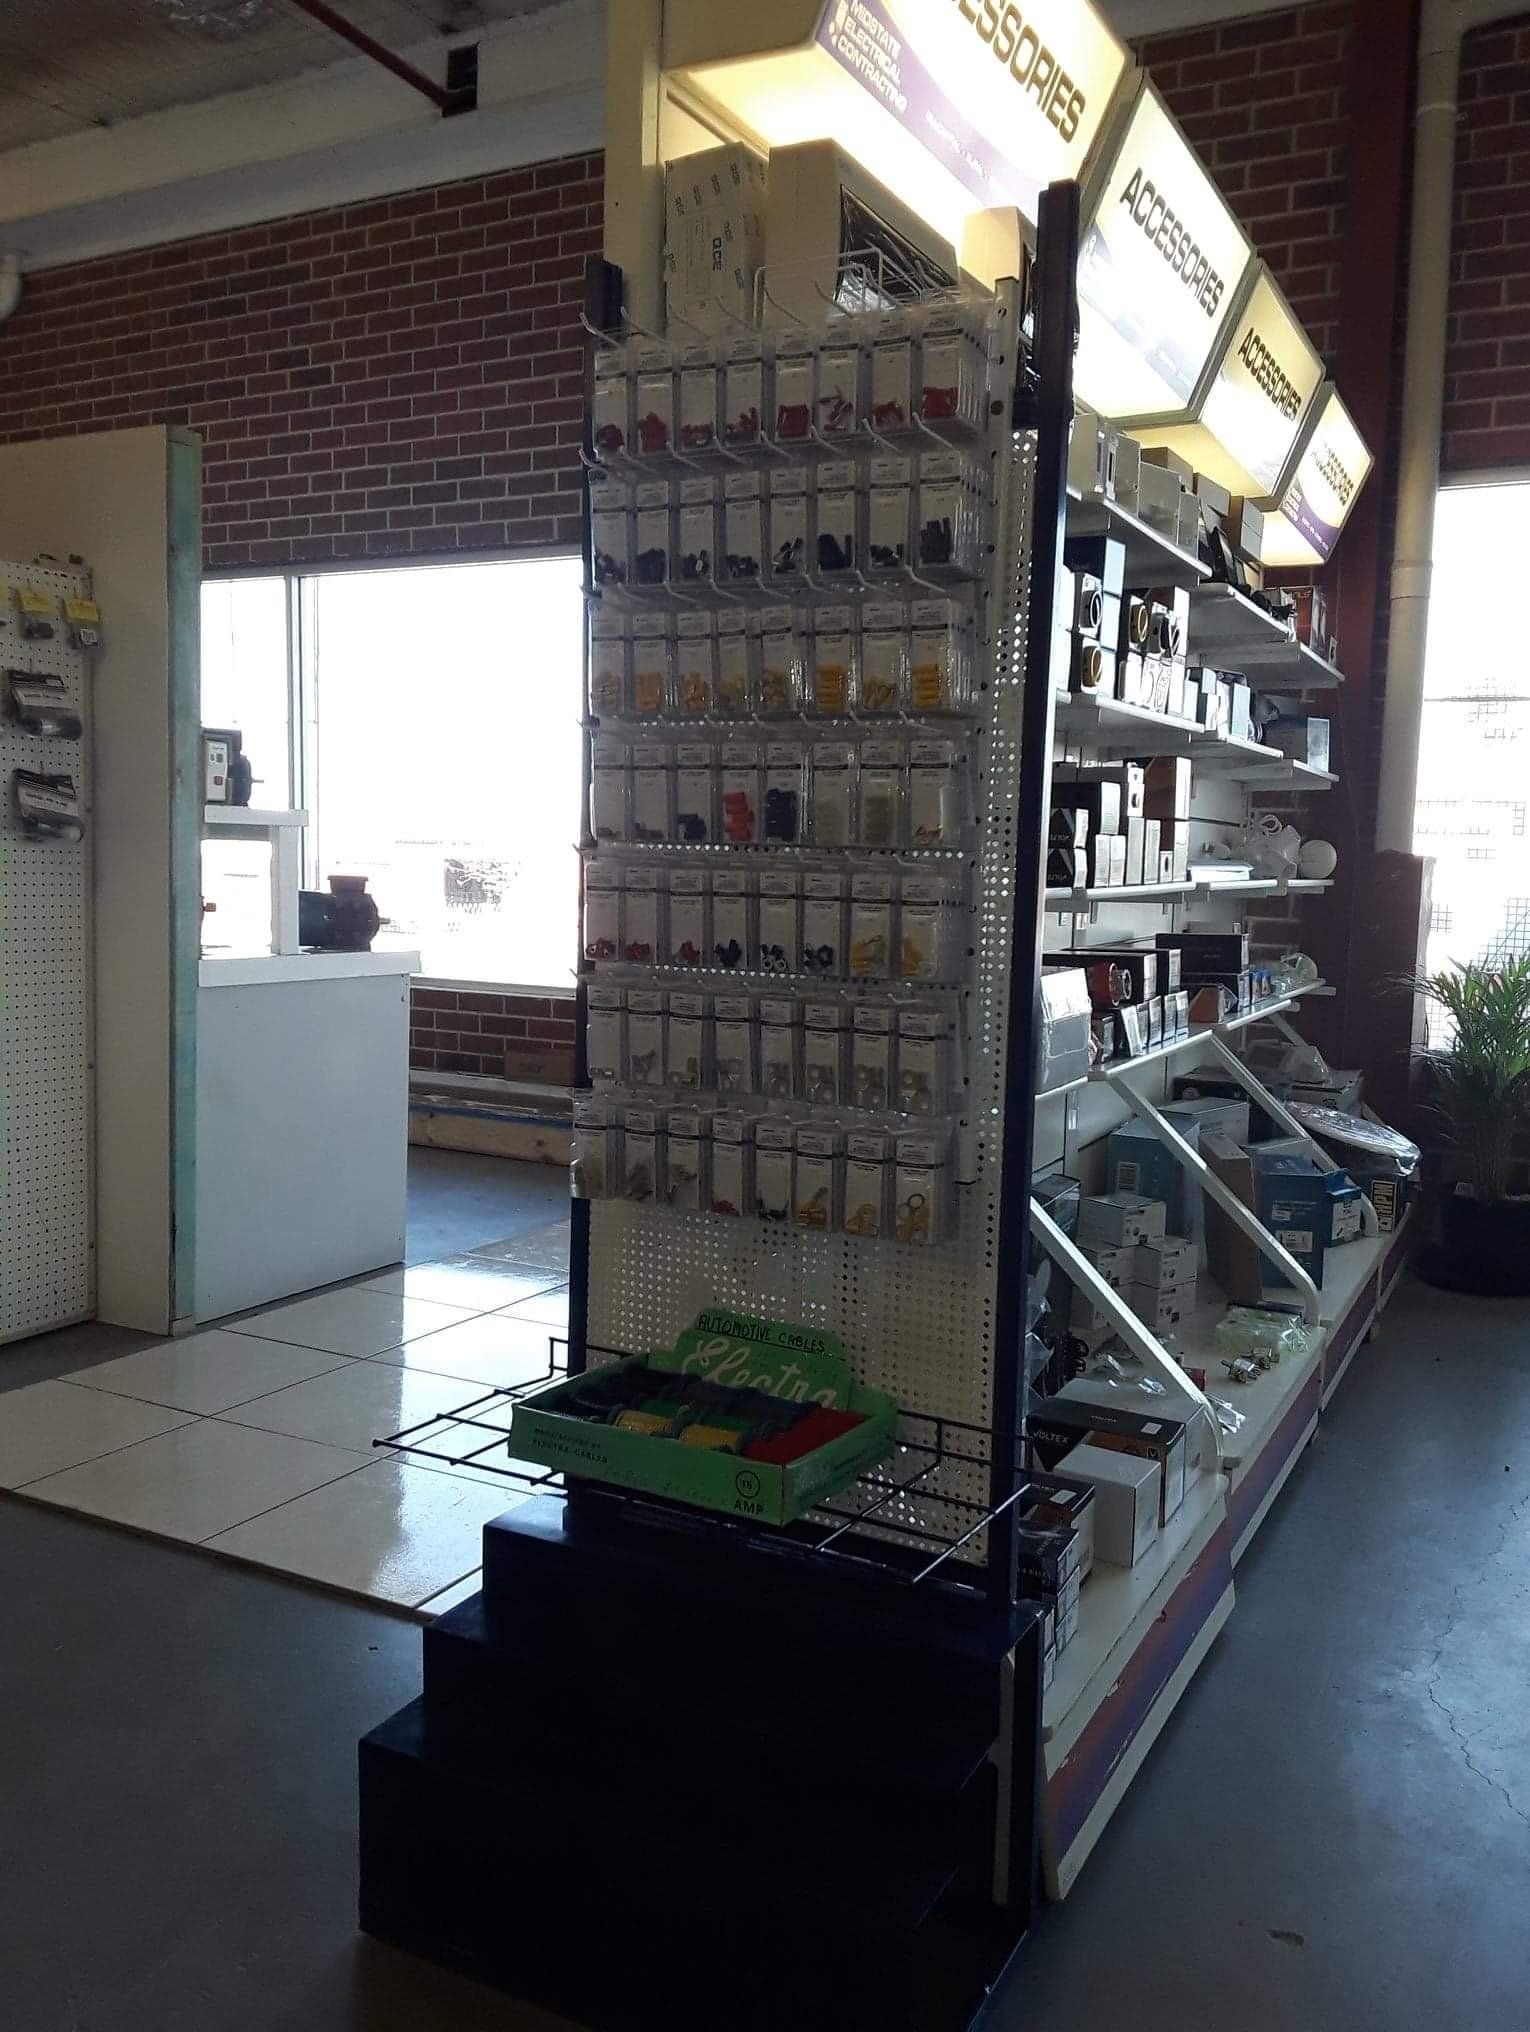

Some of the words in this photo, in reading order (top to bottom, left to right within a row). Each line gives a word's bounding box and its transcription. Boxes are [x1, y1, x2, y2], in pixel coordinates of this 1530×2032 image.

[1119, 167, 1225, 319] ACCESSORIES
[1237, 326, 1302, 422] ACCESSORIES
[698, 1314, 772, 1341] AUTOMOTIVE
[778, 1332, 826, 1352] CABLES
[734, 1499, 764, 1515] AMP
